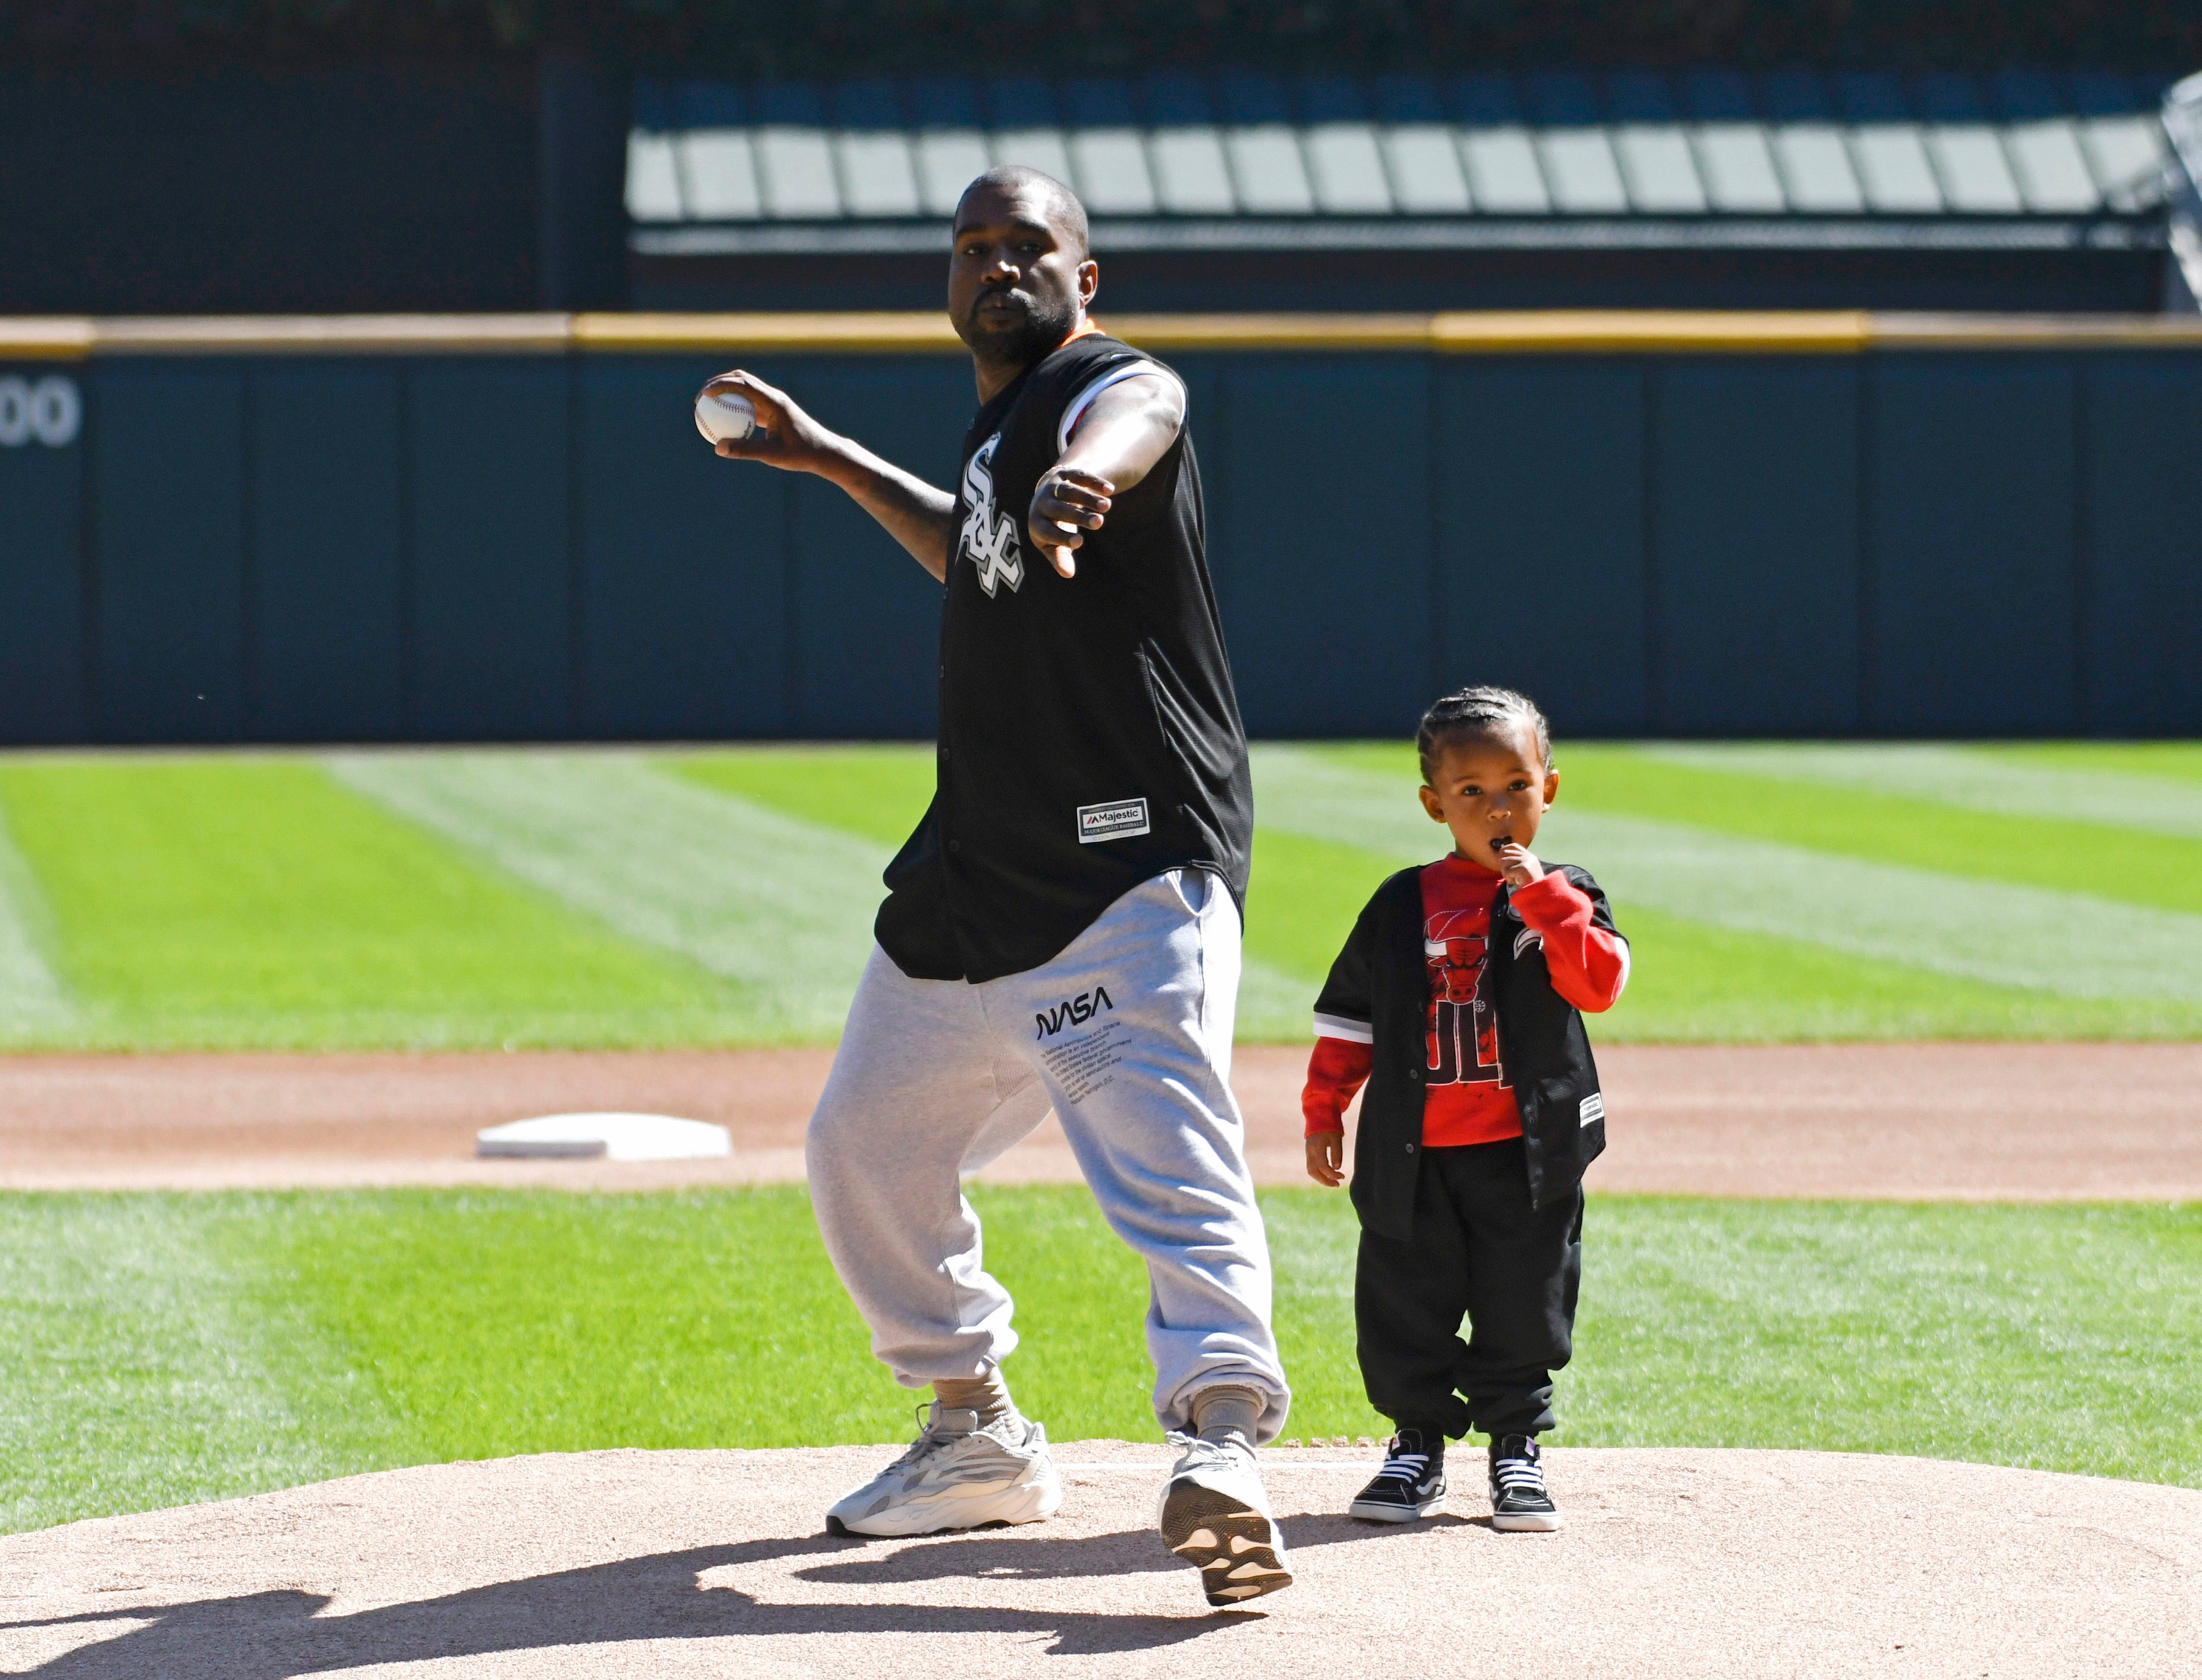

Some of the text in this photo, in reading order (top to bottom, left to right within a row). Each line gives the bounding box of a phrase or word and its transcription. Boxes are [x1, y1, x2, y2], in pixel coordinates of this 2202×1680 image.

[1099, 809, 1139, 823] Majestic
[1084, 827, 1100, 835] MAJOR
[1100, 824, 1119, 833] LEAGUE
[1036, 986, 1113, 1041] NASA
[1093, 1028, 1101, 1037] and
[1103, 1021, 1120, 1032] Space
[1090, 1041, 1106, 1052] branch
[1099, 1039, 1131, 1056] government
[1097, 1054, 1110, 1064] space
[1111, 1056, 1121, 1064] and
